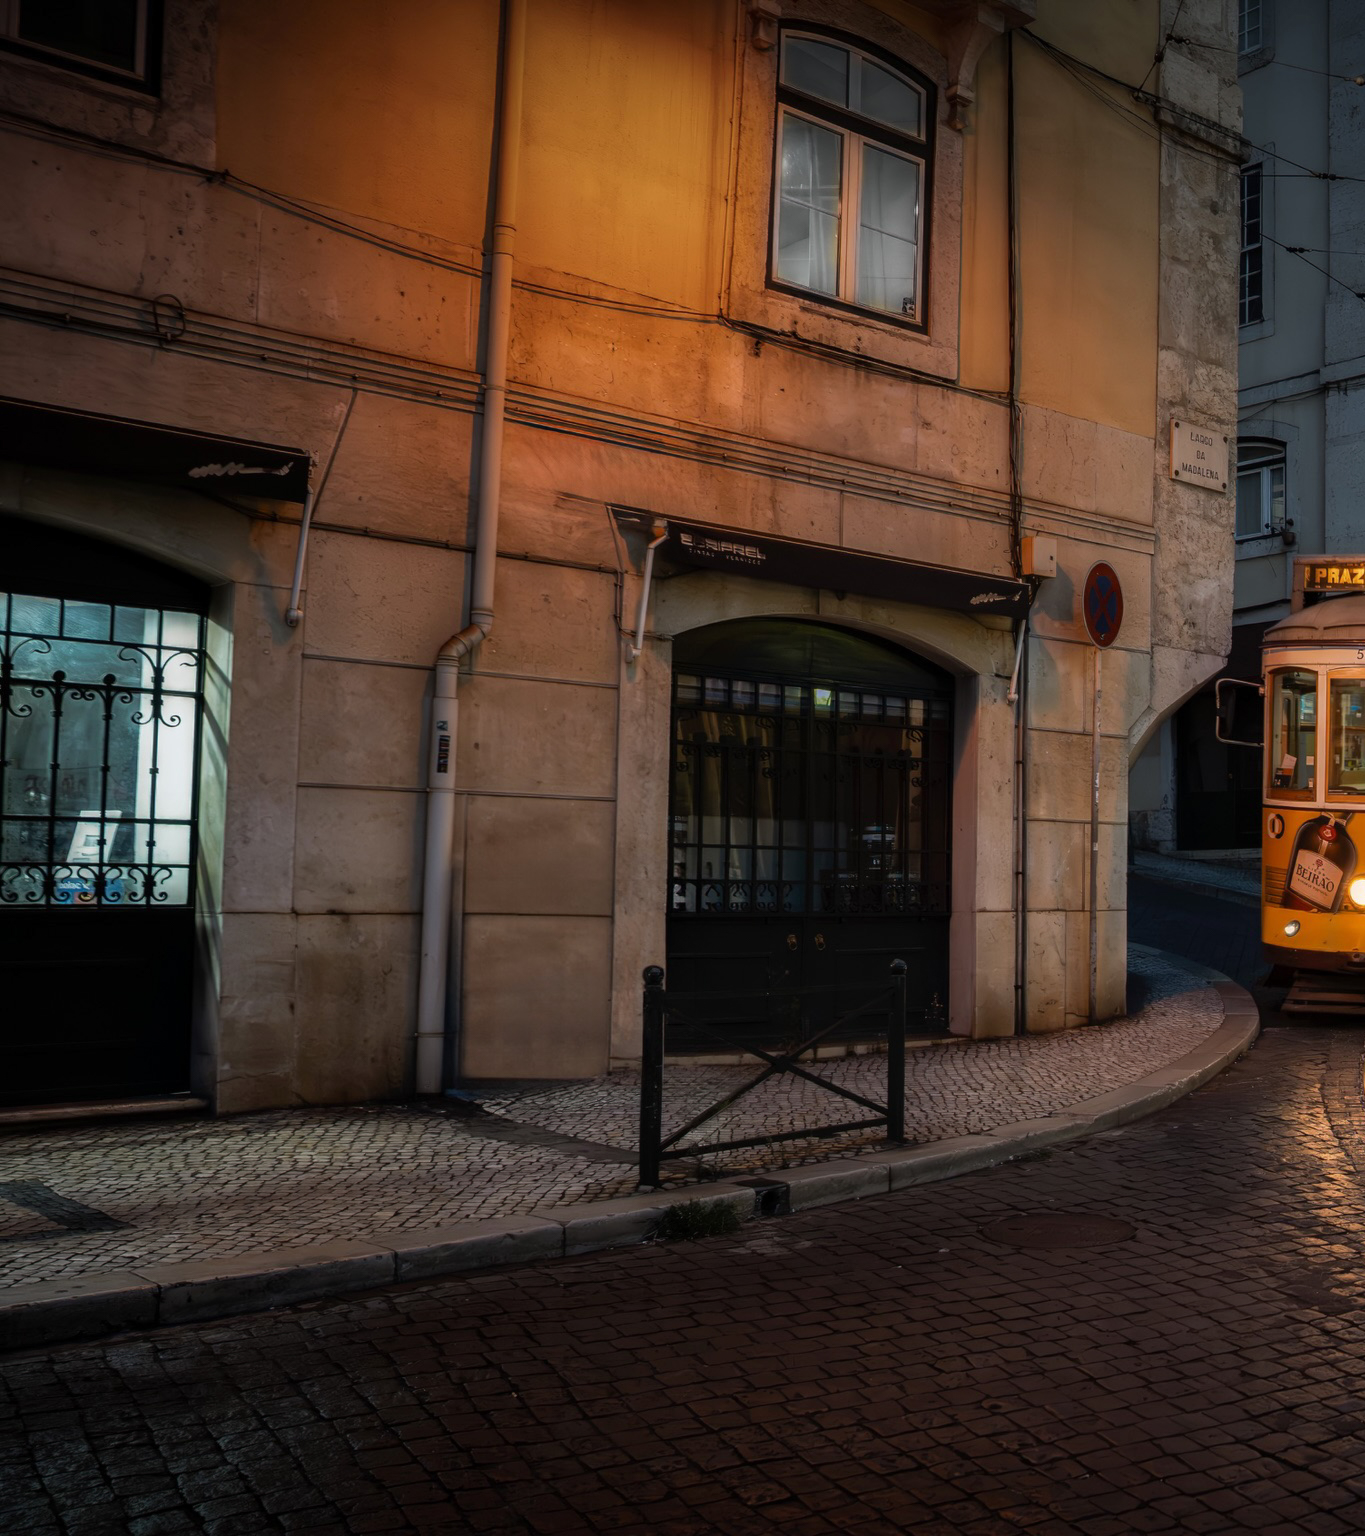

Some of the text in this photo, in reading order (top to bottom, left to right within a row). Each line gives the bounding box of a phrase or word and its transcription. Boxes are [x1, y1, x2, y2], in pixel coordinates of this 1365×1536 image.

[1190, 432, 1213, 446] LARGO
[1196, 450, 1206, 460] DA
[1182, 462, 1219, 481] MADALENA
[1295, 863, 1335, 893] BEIRÃO
